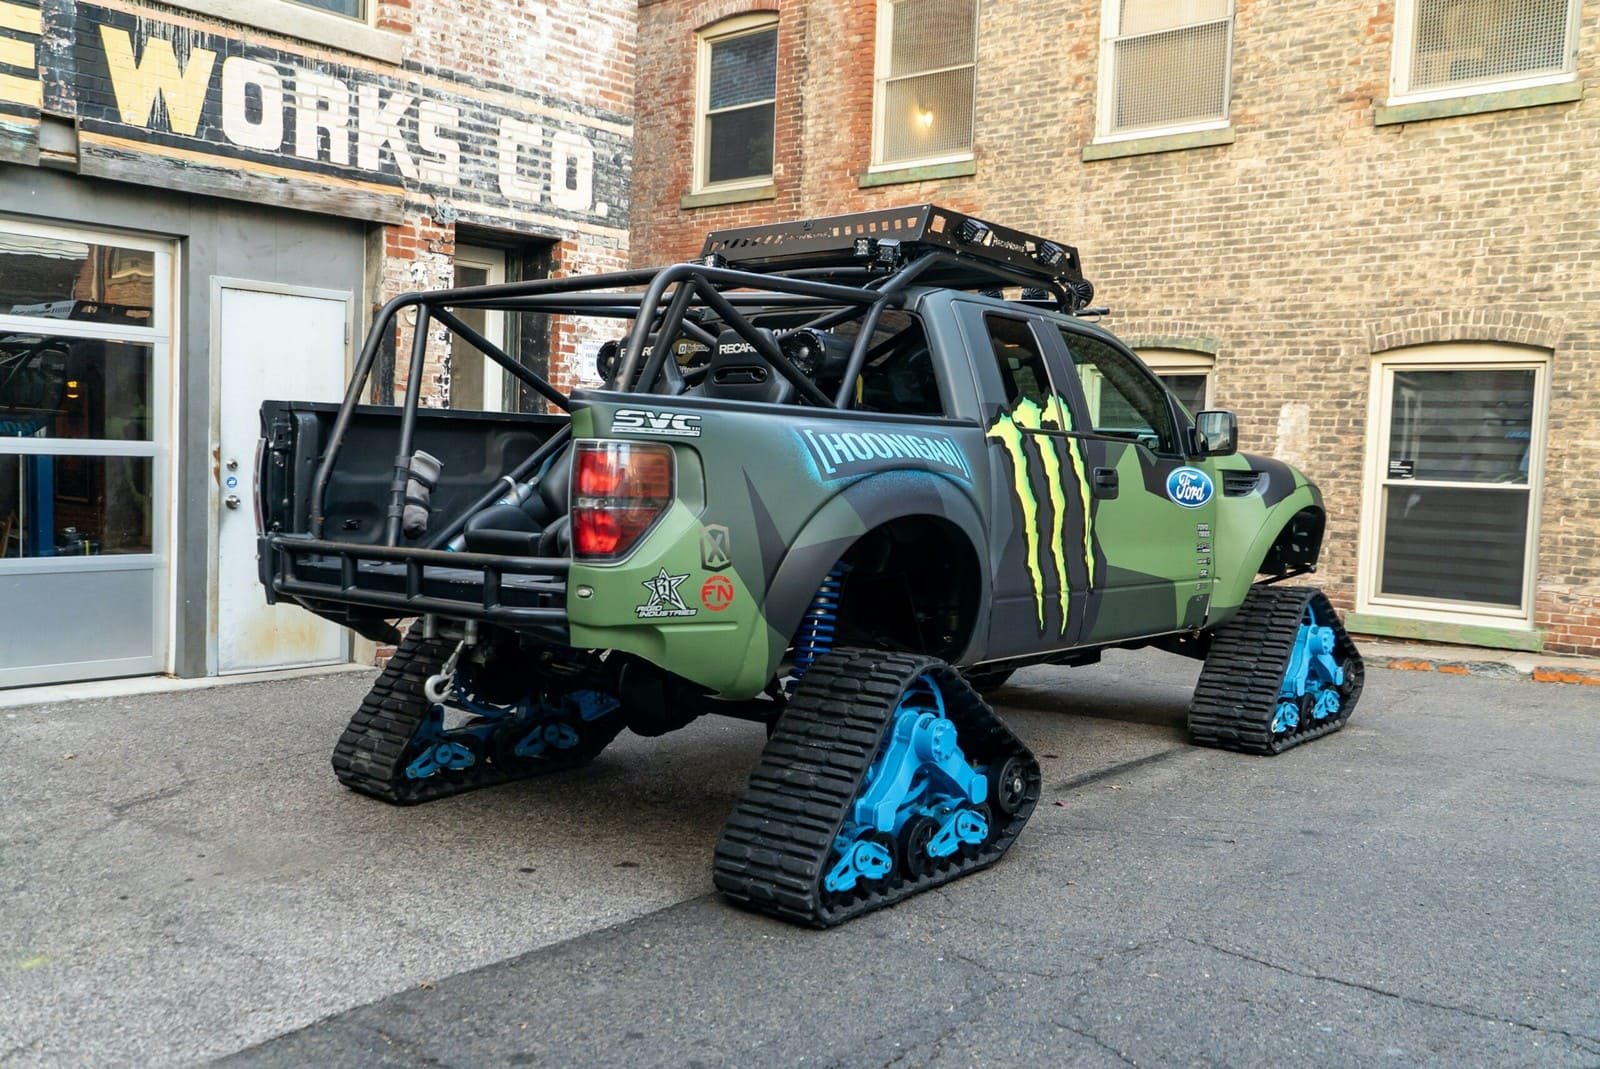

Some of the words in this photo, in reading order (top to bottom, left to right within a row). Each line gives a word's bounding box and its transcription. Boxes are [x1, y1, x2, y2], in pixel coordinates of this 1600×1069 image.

[99, 24, 461, 186] WORKS
[499, 116, 609, 218] CO.
[718, 342, 757, 356] RECAR
[1176, 471, 1205, 502] Ford
[701, 584, 734, 603] FN
